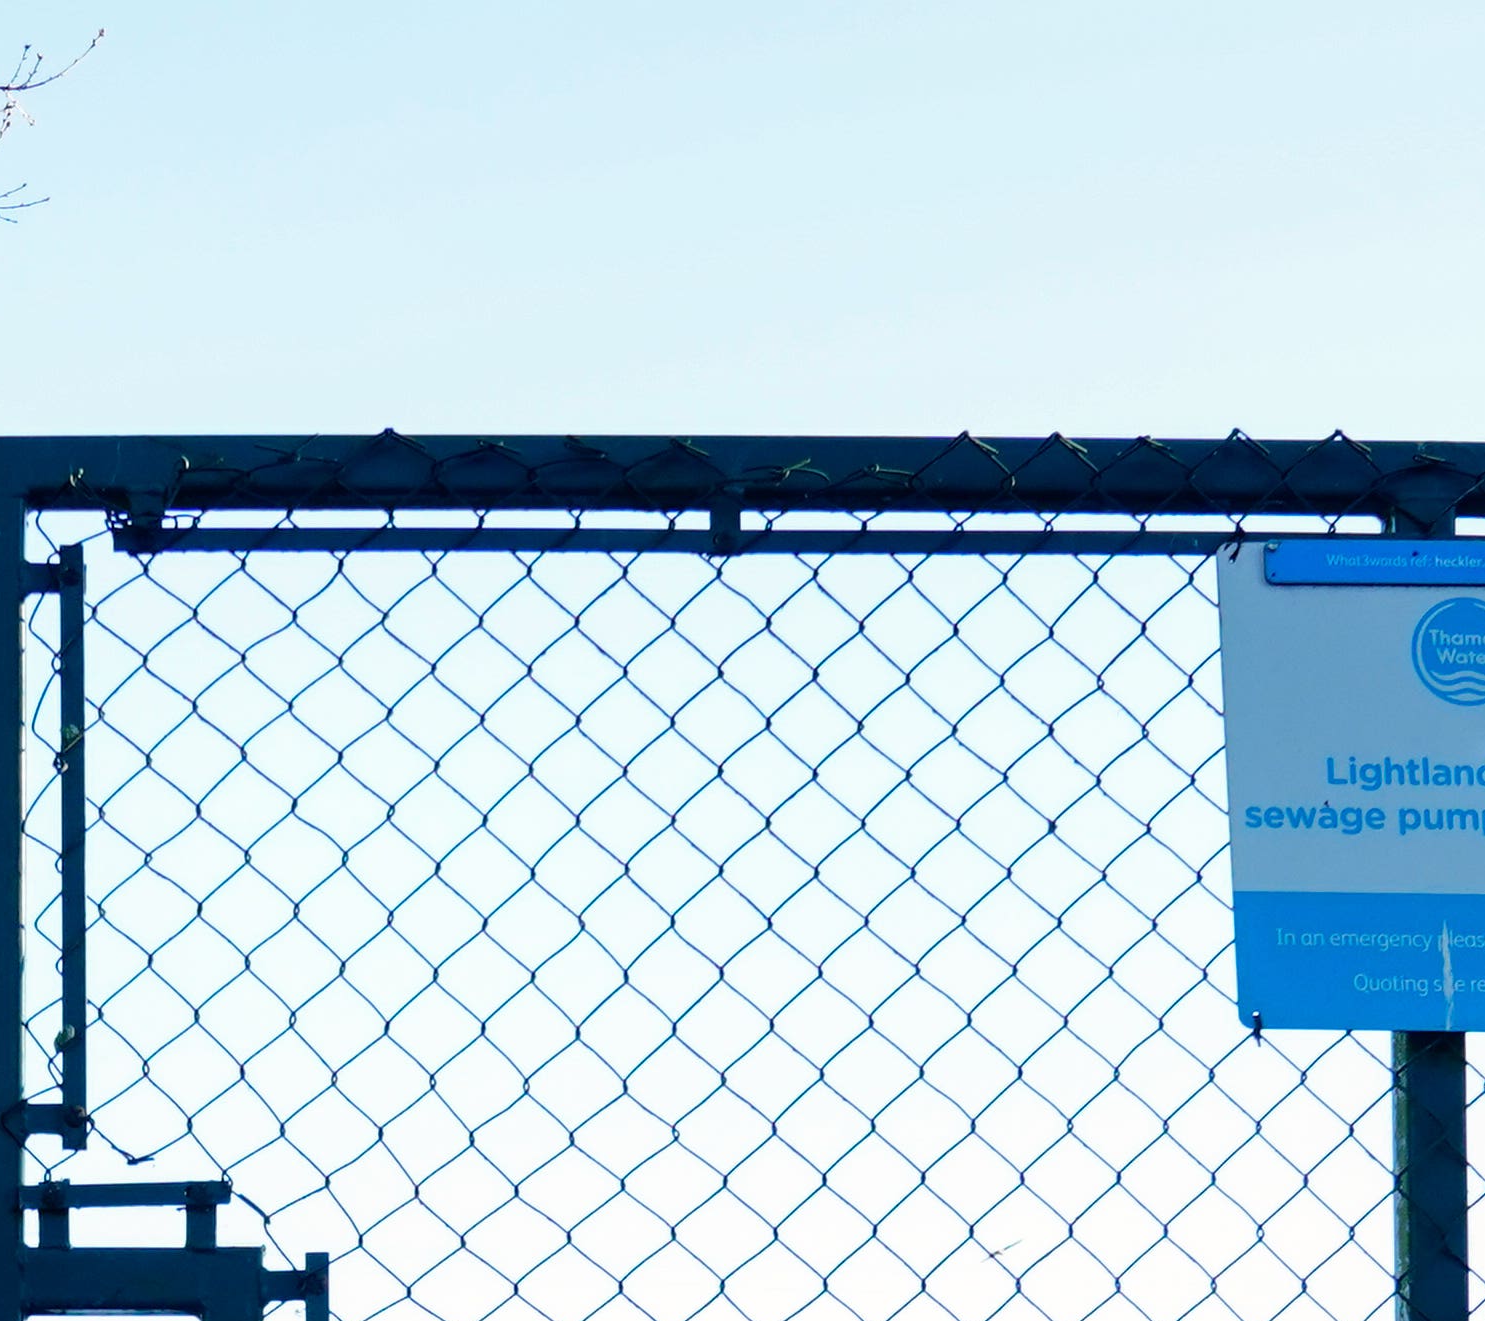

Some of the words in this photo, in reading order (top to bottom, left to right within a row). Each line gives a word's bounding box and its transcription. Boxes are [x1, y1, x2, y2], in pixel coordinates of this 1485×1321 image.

[1245, 805, 1386, 835] sewage
[1276, 928, 1296, 946] In
[1301, 932, 1324, 945] an
[1330, 932, 1432, 952] emergency
[1354, 974, 1429, 997] Quoting
[1433, 978, 1465, 993] se
